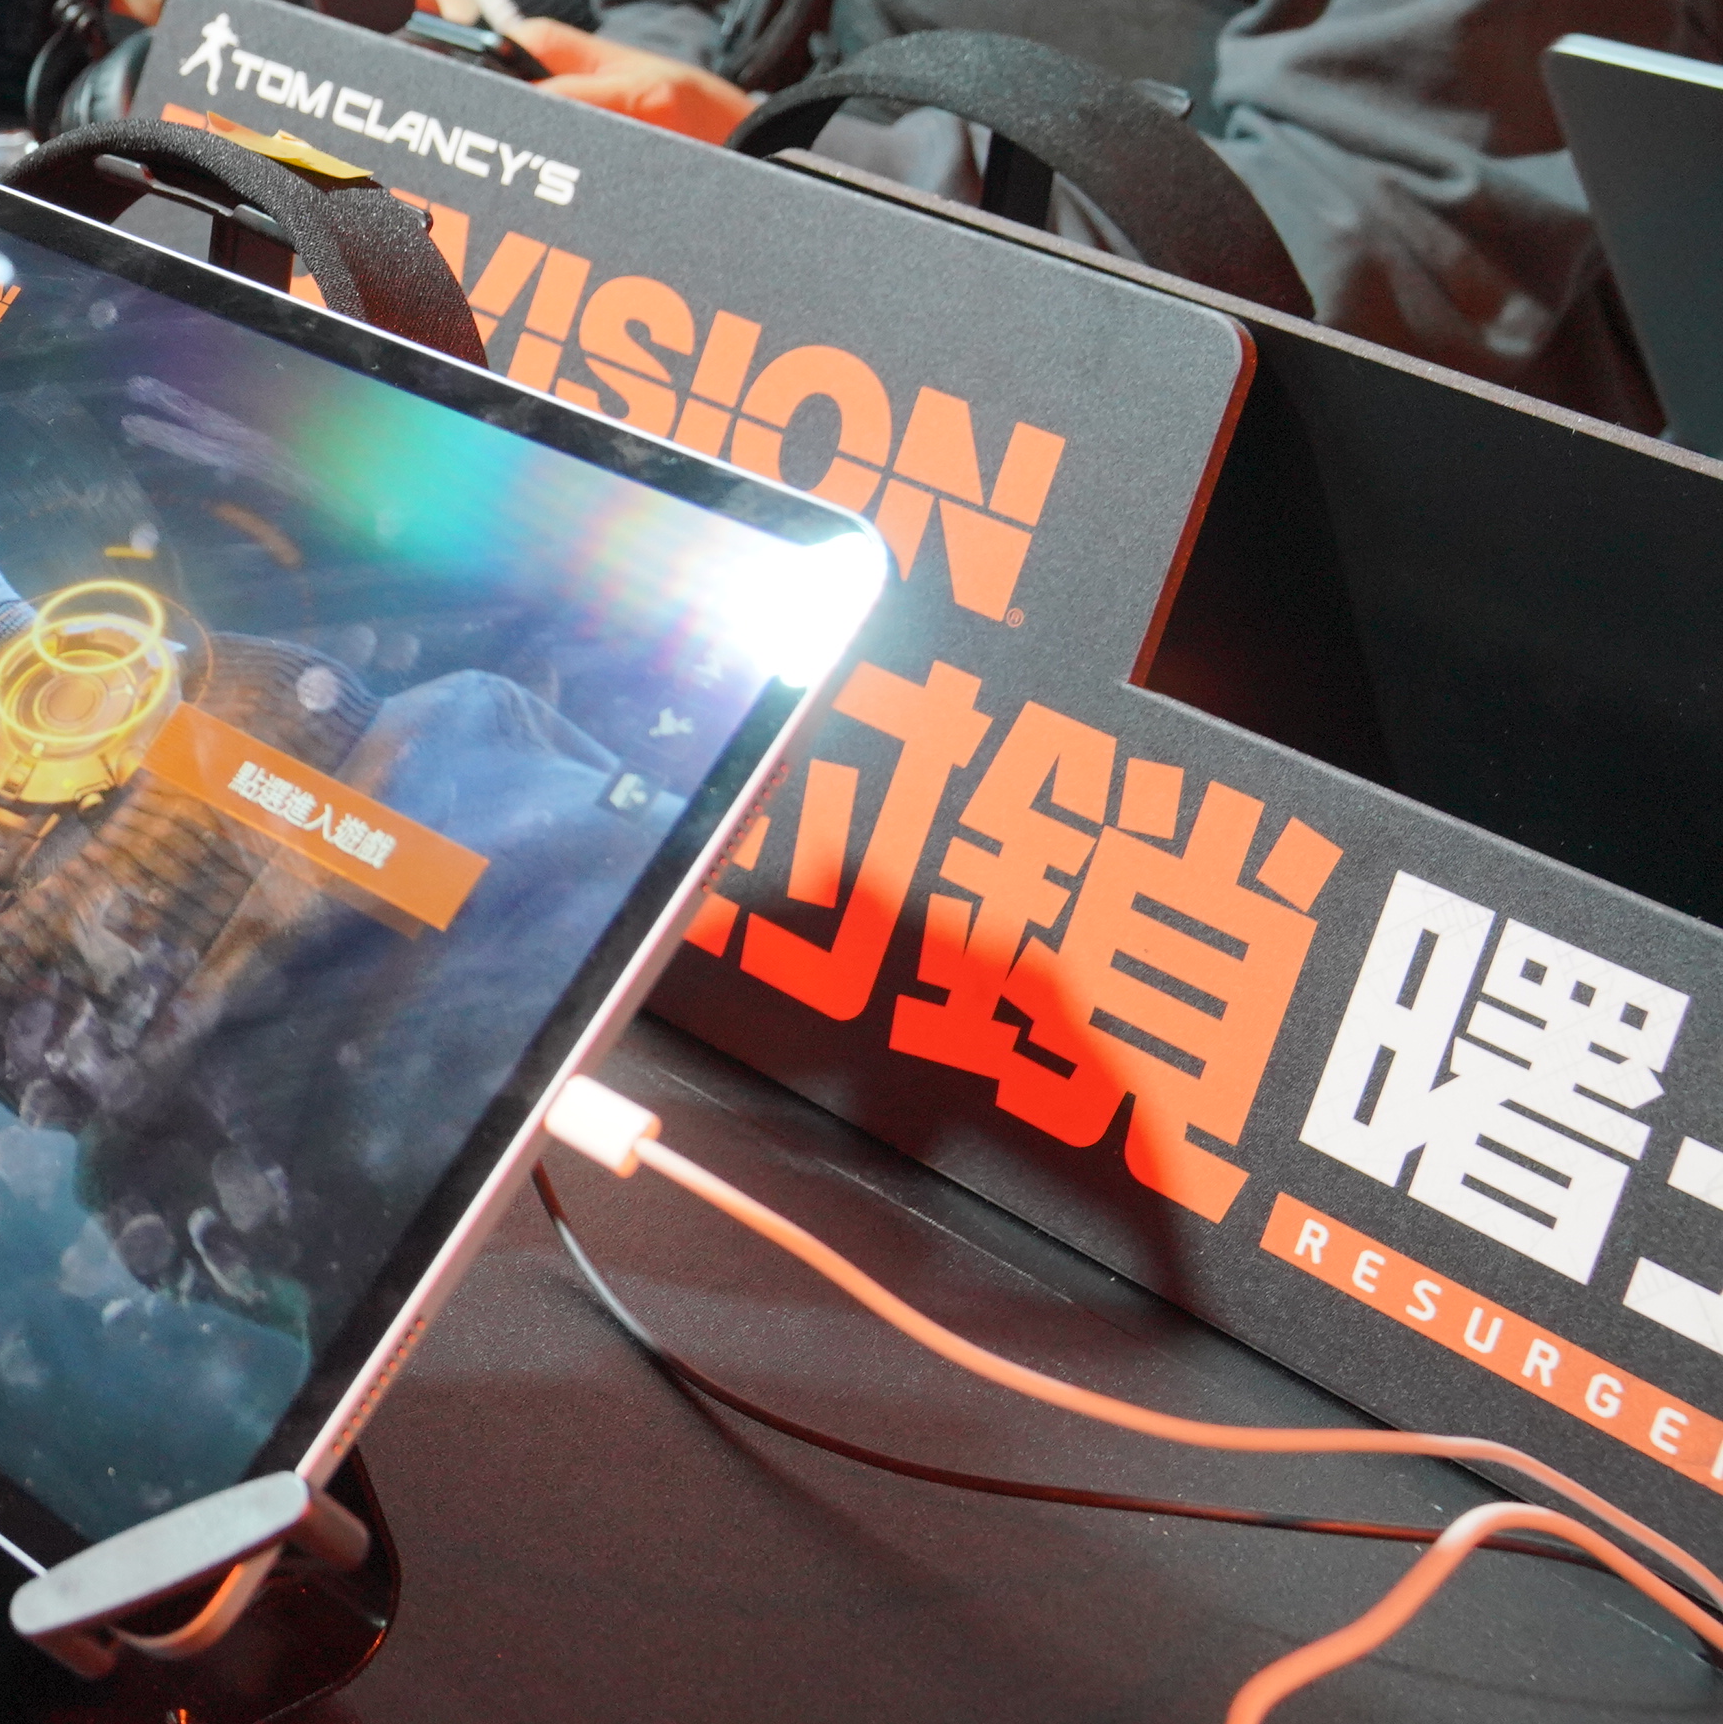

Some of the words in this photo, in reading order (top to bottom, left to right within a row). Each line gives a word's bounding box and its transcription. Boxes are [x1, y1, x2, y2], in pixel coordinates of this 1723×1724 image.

[231, 49, 334, 119] TOM
[331, 86, 581, 207] CLANCY'S
[289, 187, 1066, 622] VISION
[227, 760, 397, 869] 點選進入遊戲
[1293, 1218, 1723, 1480] RESURGE
